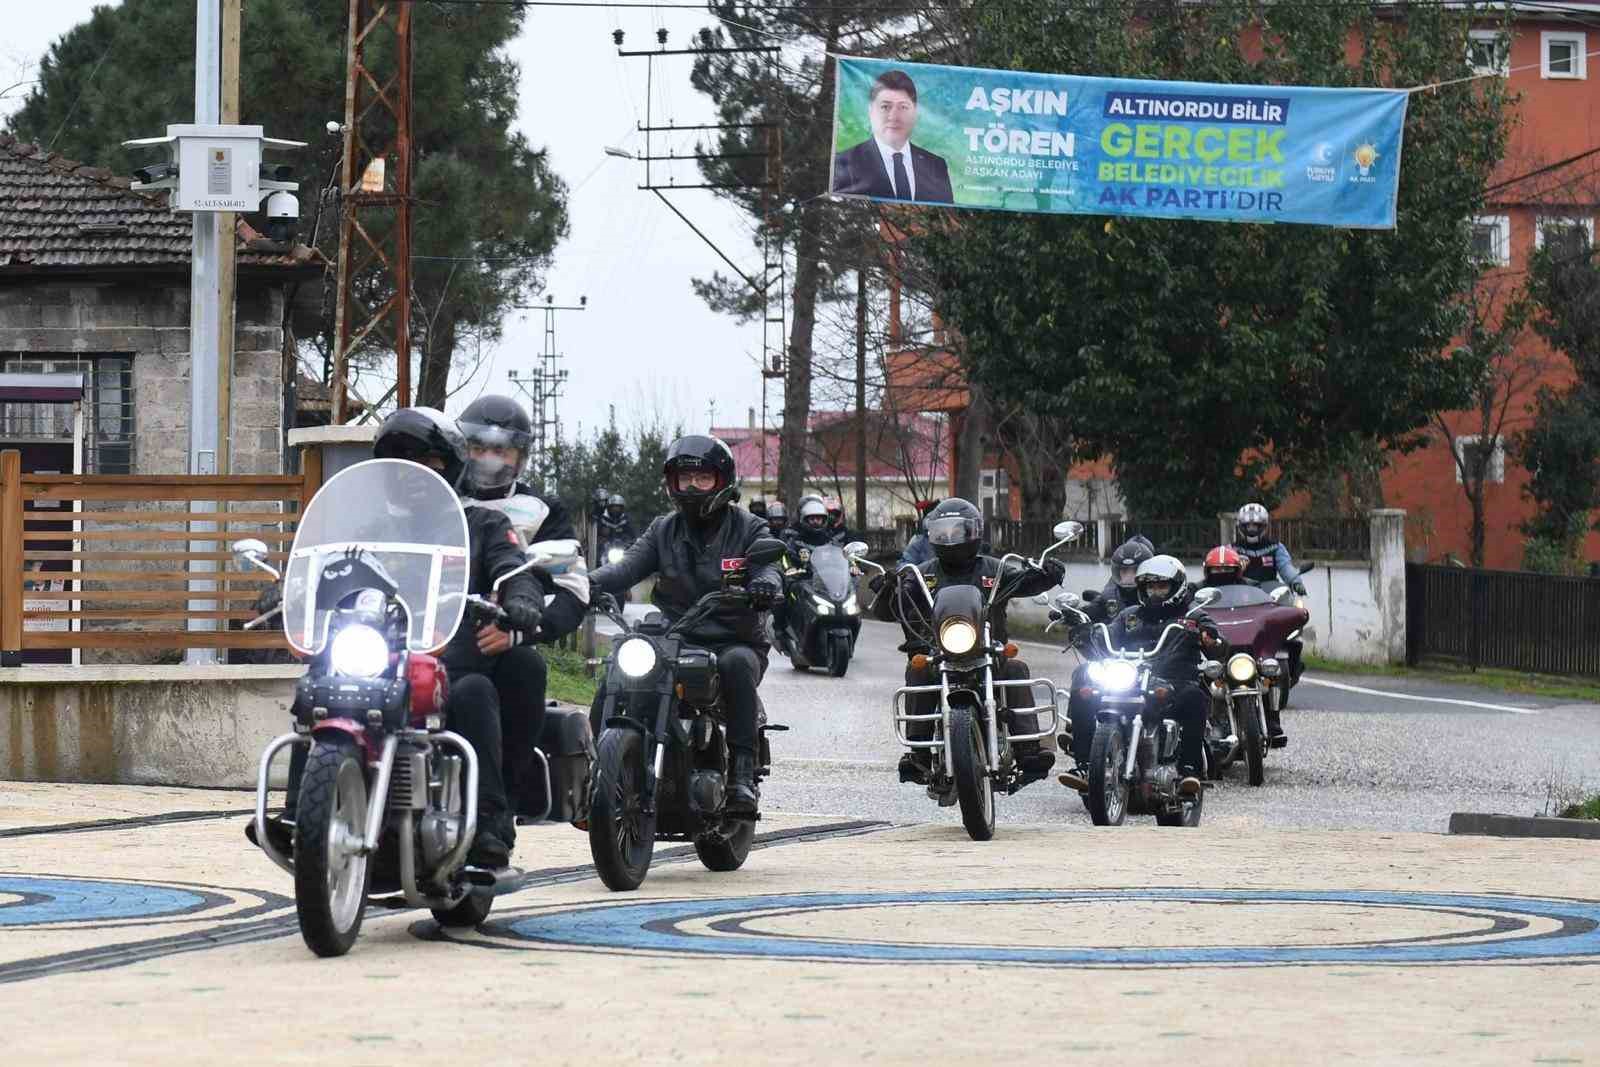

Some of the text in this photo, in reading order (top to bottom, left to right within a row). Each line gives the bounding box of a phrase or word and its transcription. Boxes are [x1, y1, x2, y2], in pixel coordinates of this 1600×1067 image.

[965, 86, 1068, 117] AŞKIN
[1109, 98, 1283, 122] ALTINORDU BİLİR
[963, 122, 1075, 157] TÖREN
[1100, 122, 1288, 164] GERÇEK
[965, 155, 1026, 168] ALTINORDU
[1010, 169, 1043, 180] ADAYI
[1099, 187, 1137, 206] AK
